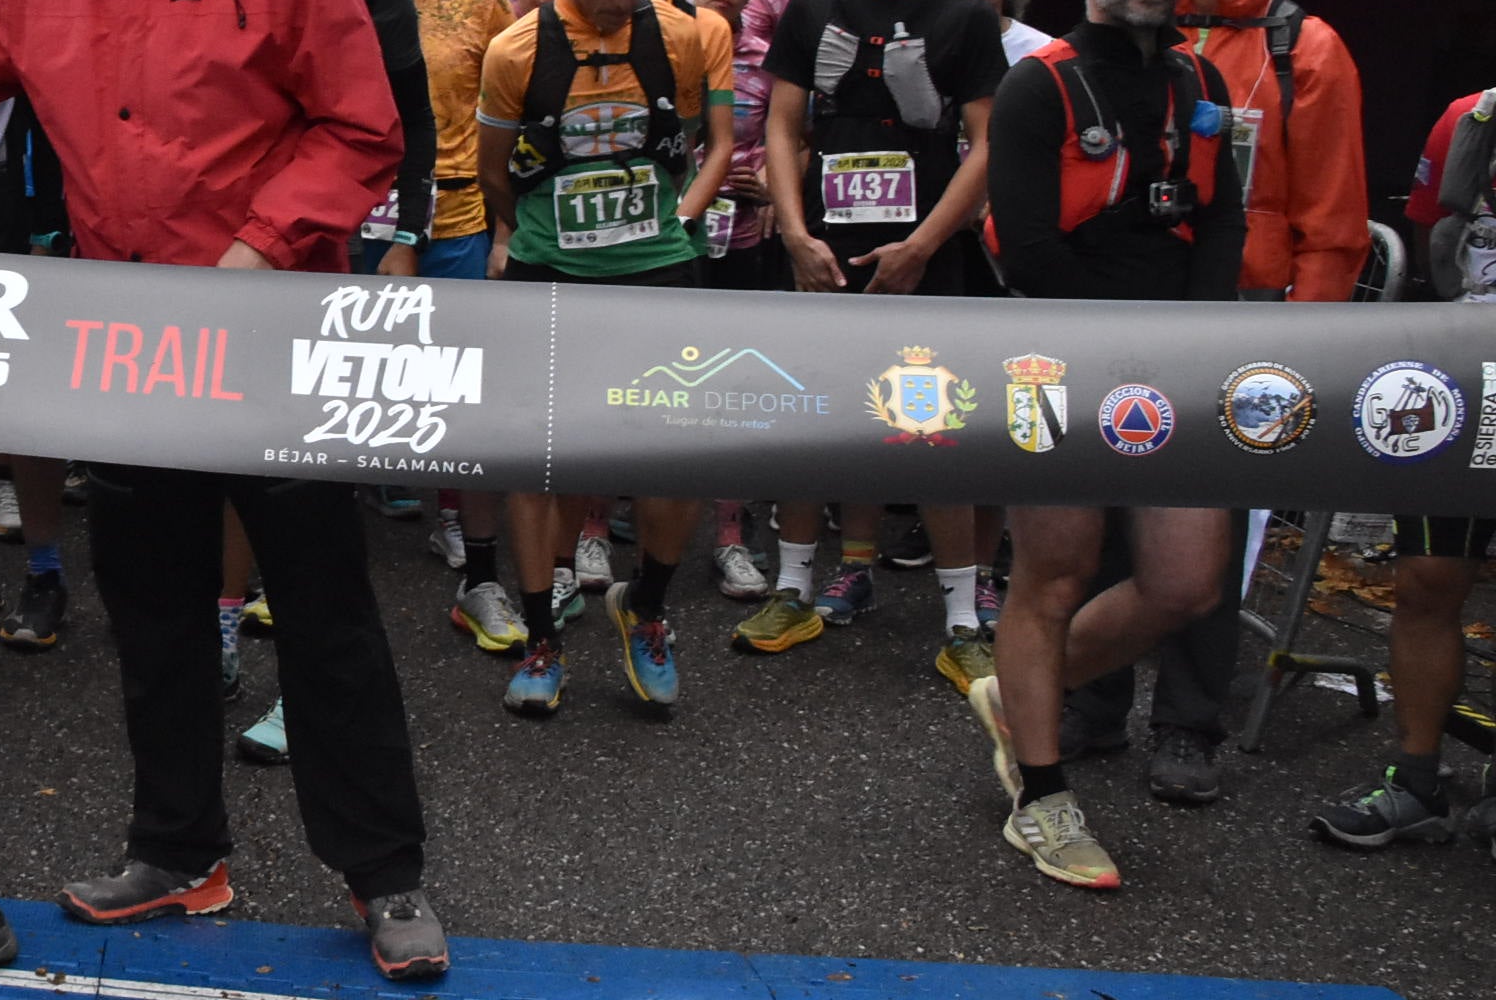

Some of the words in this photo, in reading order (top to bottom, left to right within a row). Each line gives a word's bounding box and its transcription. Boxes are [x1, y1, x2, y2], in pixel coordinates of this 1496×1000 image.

[832, 172, 902, 201] 1437
[569, 187, 645, 224] 1173
[320, 283, 436, 345] RUTA
[65, 319, 244, 401] TRAIL
[290, 338, 484, 404] VETONA
[606, 379, 691, 409] BÉJAR
[704, 391, 831, 415] DEPORTE
[1101, 387, 1152, 428] PROTECCION
[1352, 360, 1424, 418] CANDELARIENSE
[1431, 368, 1450, 383] DE
[303, 399, 449, 454] 2025
[1155, 399, 1173, 432] CIVIL
[264, 445, 329, 466] BÉJAR
[357, 455, 485, 476] SALAMANCA
[1114, 440, 1155, 454] BEJAR
[1354, 426, 1381, 458] GRUPO
